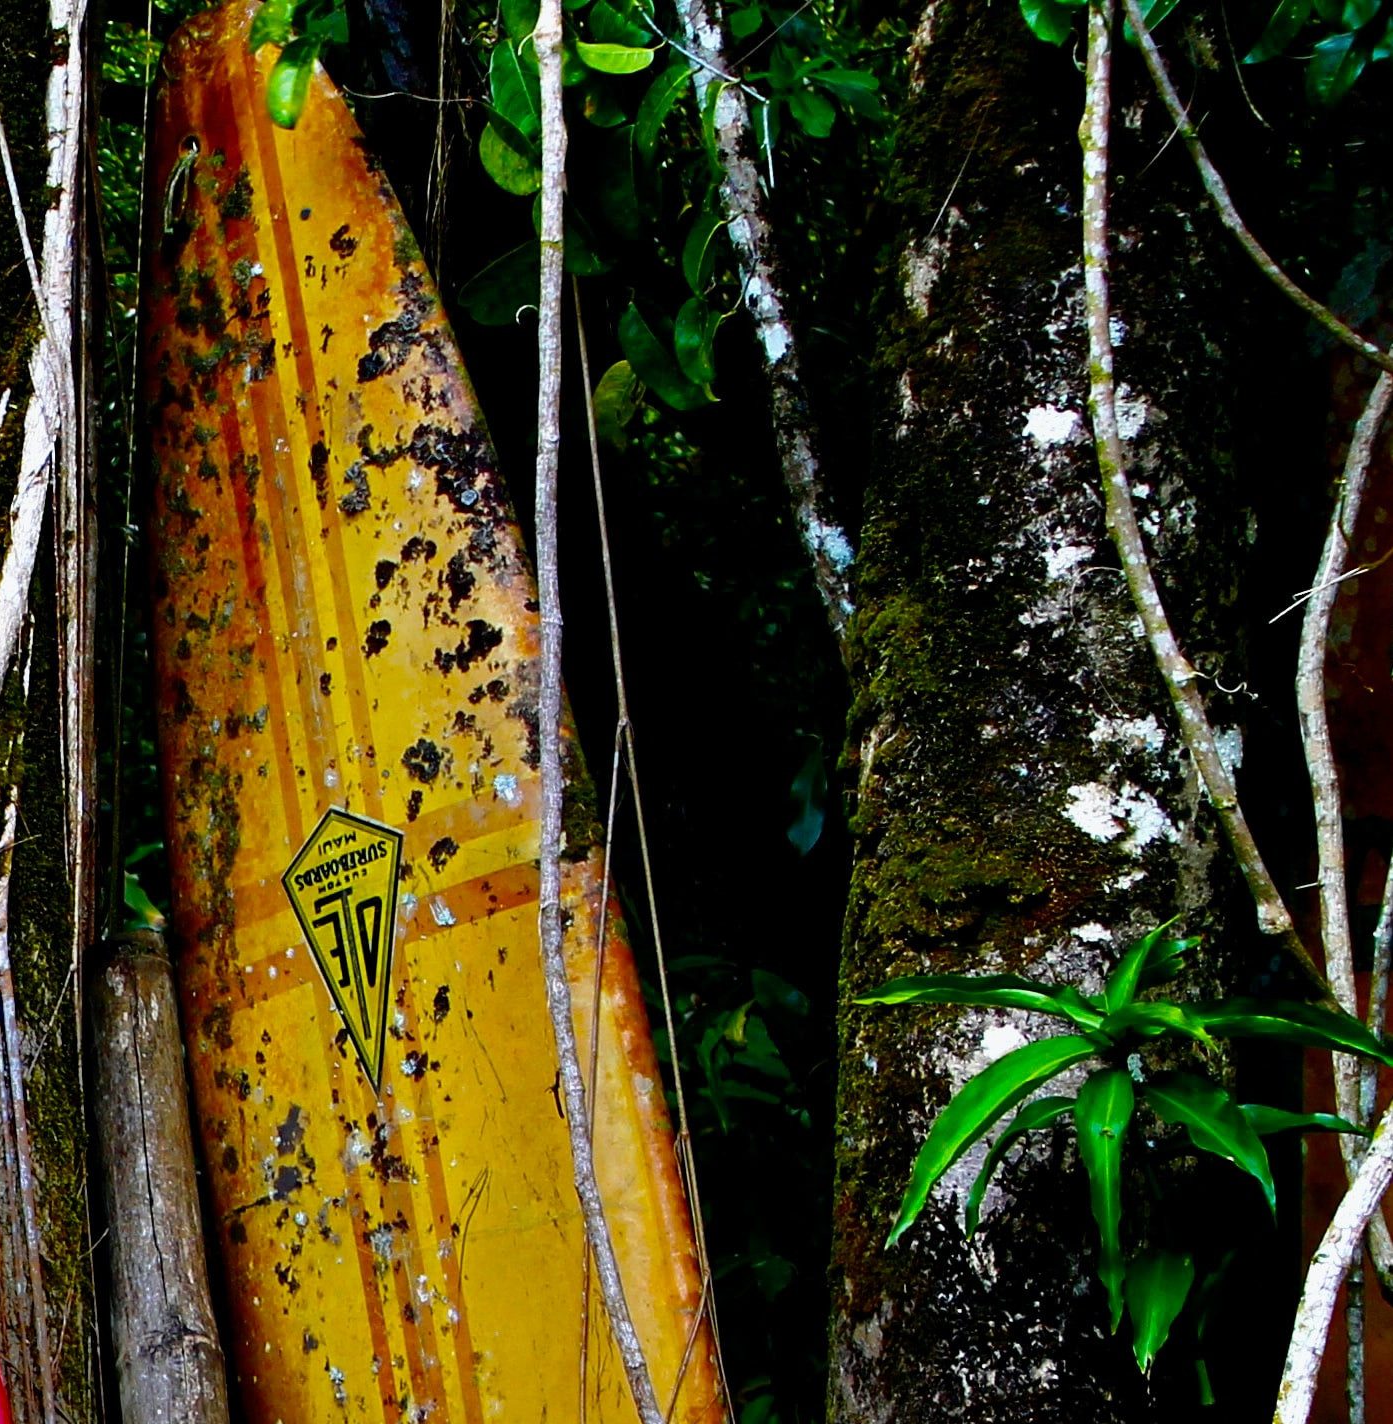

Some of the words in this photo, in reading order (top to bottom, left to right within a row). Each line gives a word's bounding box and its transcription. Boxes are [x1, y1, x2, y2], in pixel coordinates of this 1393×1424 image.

[318, 831, 356, 856] MAUI
[294, 840, 388, 891] SURFBOARDS
[317, 868, 367, 894] CUSTOM
